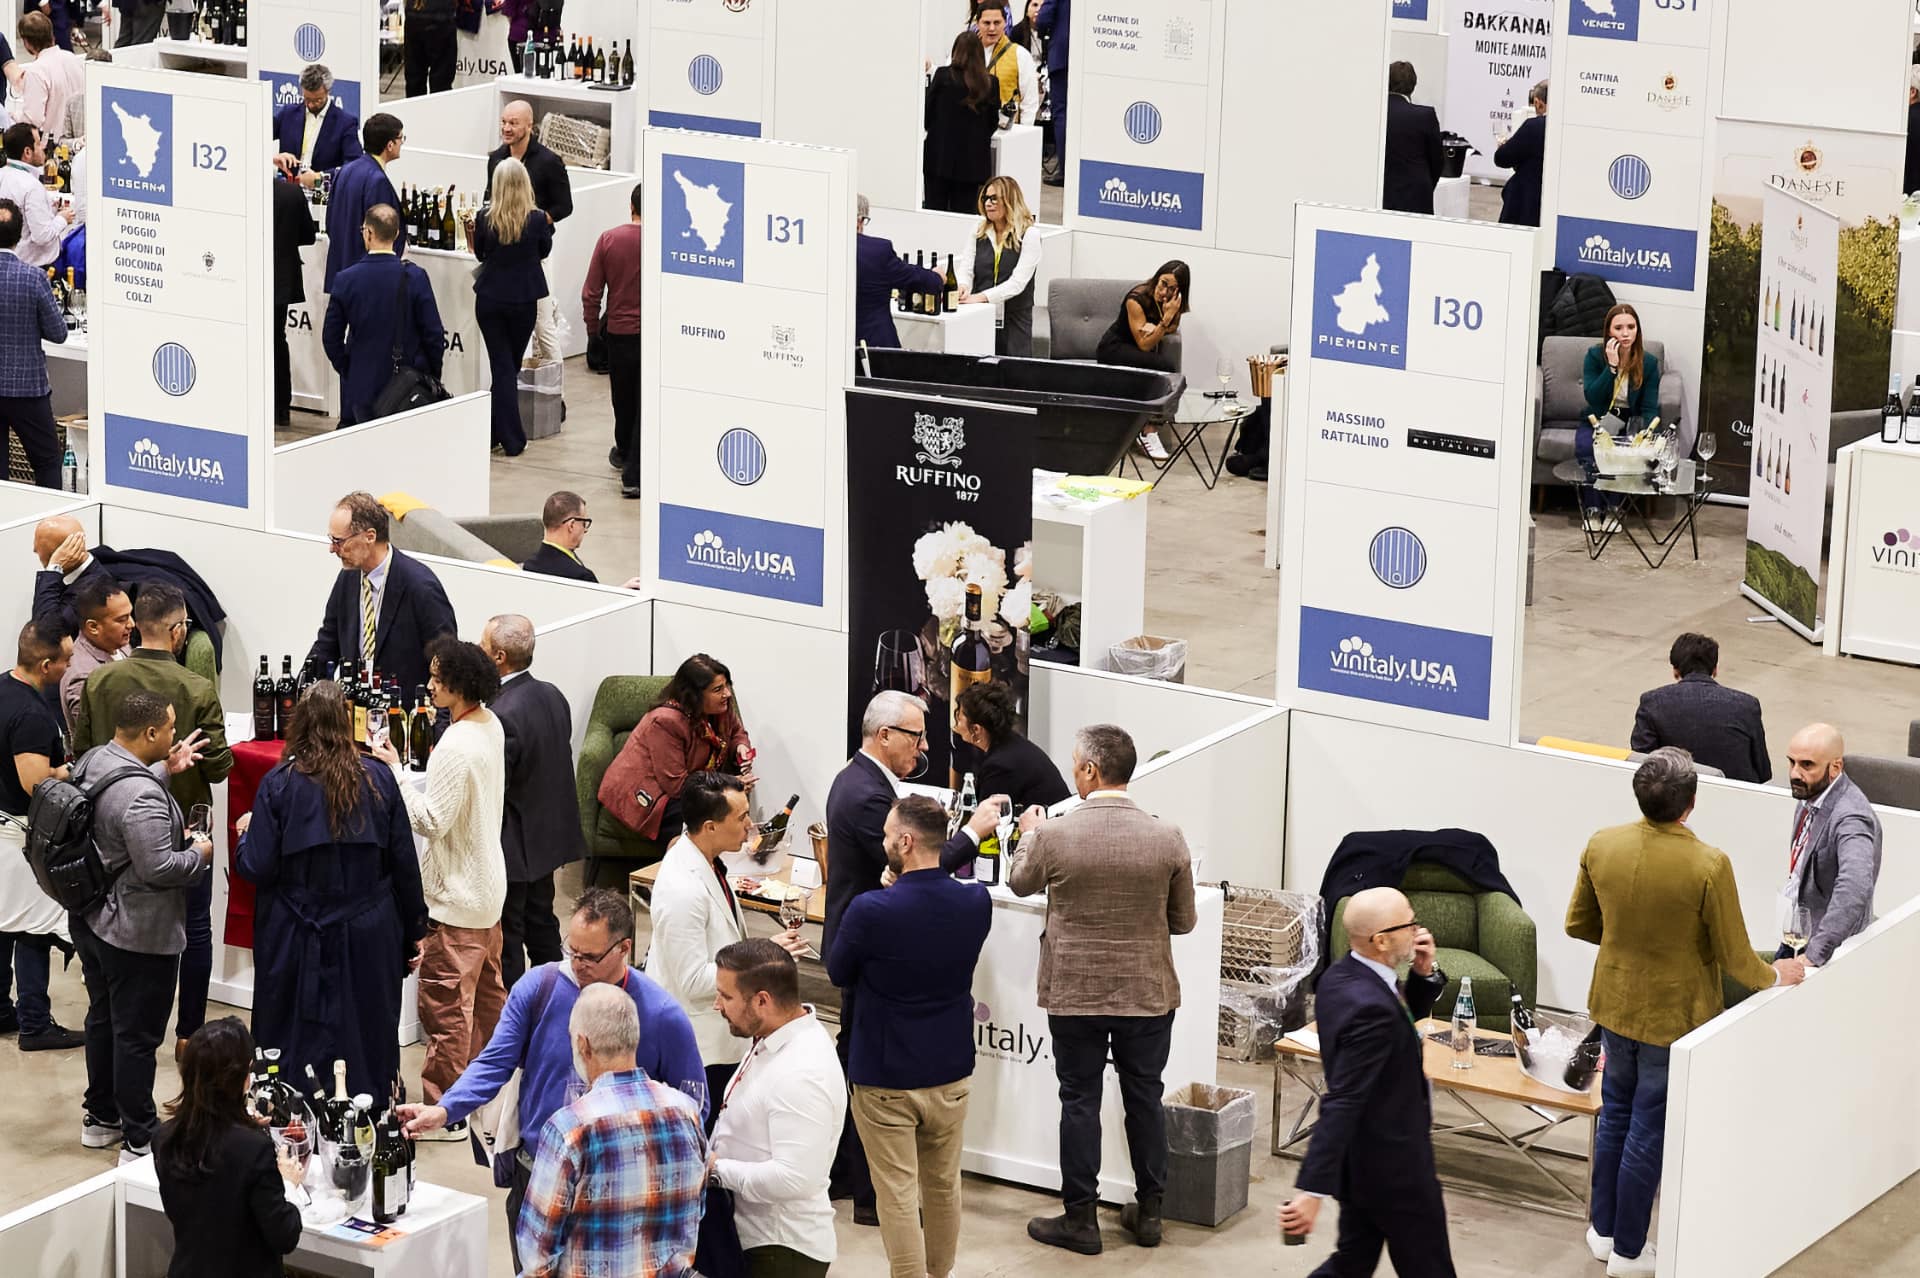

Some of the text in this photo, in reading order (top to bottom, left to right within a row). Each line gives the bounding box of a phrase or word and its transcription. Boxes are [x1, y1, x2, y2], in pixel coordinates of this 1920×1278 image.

[1096, 13, 1129, 25] CANTINE
[1582, 18, 1625, 30] VENETO
[1092, 26, 1123, 37] VERONA
[1474, 40, 1547, 59] MONTE AMIATA
[457, 56, 508, 76] aly.USA
[1488, 61, 1533, 79] TUSCANY
[1579, 71, 1619, 84] CANTINA
[1580, 85, 1617, 97] DANESE
[192, 142, 228, 171] I32
[110, 176, 166, 193] TOSCANA
[1770, 173, 1846, 197] DANESE
[1098, 186, 1182, 210] vinitaly.USA
[116, 207, 161, 223] FATTORIA
[120, 224, 157, 239] POGGIO
[766, 213, 805, 245] I31
[112, 239, 166, 257] CAPPONI DI
[1578, 244, 1672, 269] vinitaly.USA
[114, 256, 163, 273] GIOCONDA
[670, 250, 736, 268] TOSCANA
[114, 272, 164, 289] ROUSSEAU
[125, 290, 153, 304] COLZI
[1433, 295, 1484, 331] I30
[680, 324, 726, 341] RUFFINO
[1318, 334, 1401, 355] PIEMONTE
[762, 350, 804, 363] RUFFINO
[1325, 409, 1386, 430] MASSIMO
[1320, 428, 1390, 449] RATTALINO
[127, 449, 225, 481] vinitaly.USA
[895, 465, 982, 491] RUFFINO
[955, 490, 980, 503] 1877
[686, 542, 796, 577] vinitaly.USA
[1329, 650, 1458, 688] vinitaly.USA
